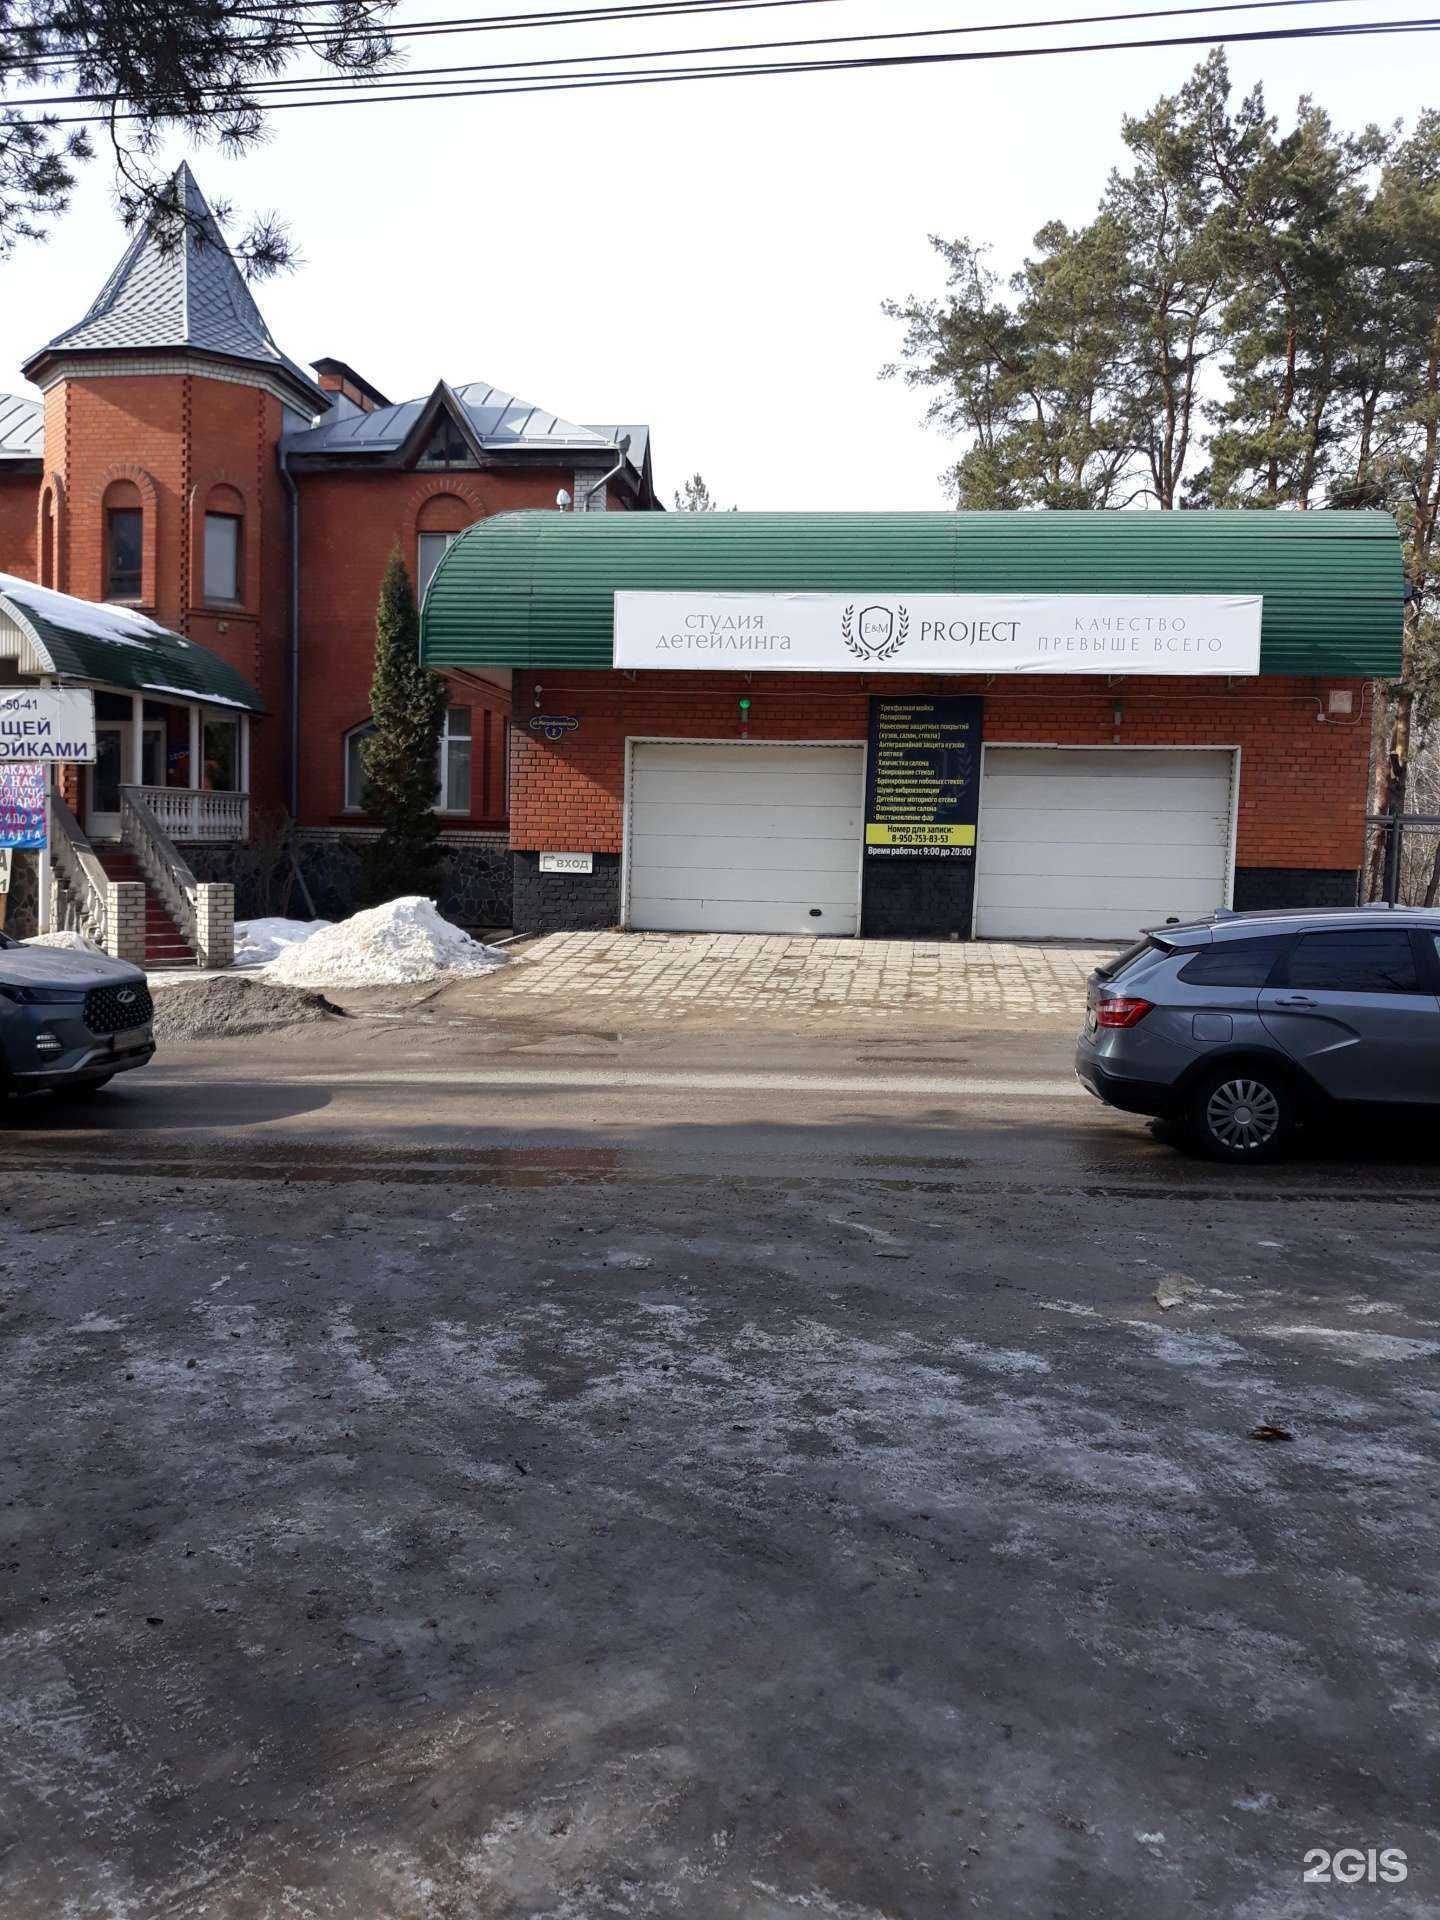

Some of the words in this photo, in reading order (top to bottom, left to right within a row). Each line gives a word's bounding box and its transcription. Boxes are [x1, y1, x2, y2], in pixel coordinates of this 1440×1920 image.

[685, 614, 764, 634] студия
[1074, 617, 1186, 632] КАЧЕСТВО
[864, 623, 889, 634] E&M
[920, 621, 1021, 647] PROJECT
[656, 631, 791, 651] детейлинга
[1037, 637, 1140, 651] ПРЕВЫШЕ
[1153, 638, 1222, 652] ВСЕГО
[0, 699, 38, 710] -50-41
[0, 797, 44, 809] ОДАРОК
[887, 825, 911, 834] Номер
[912, 826, 926, 834] для
[927, 826, 954, 834] записи:
[891, 834, 949, 843] 8-950-753-83-53
[868, 846, 890, 856] Время
[891, 847, 918, 856] работы
[940, 849, 950, 857] до
[950, 848, 972, 856] 20:00
[557, 859, 589, 870] ВХОД
